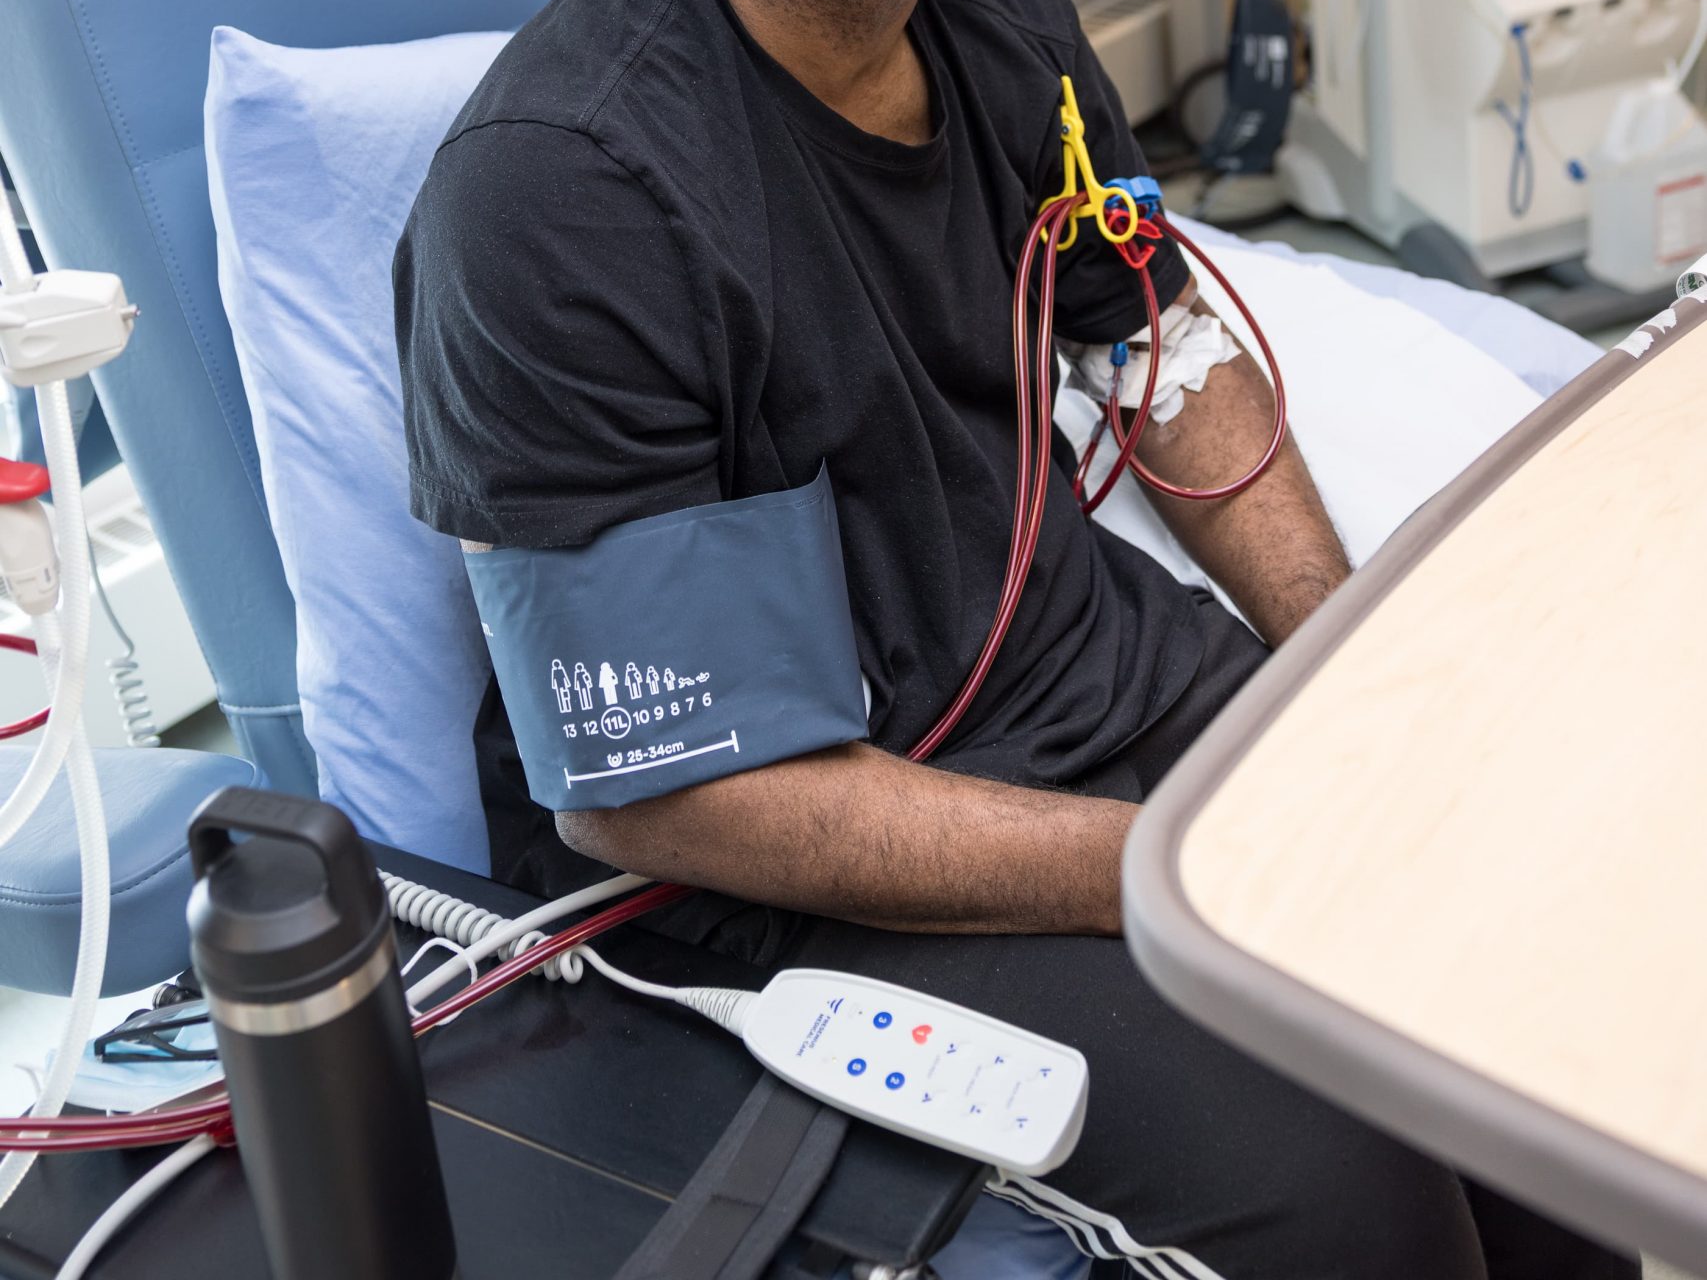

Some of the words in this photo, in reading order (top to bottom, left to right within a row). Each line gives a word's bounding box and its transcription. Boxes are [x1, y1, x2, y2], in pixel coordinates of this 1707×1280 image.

[563, 724, 578, 738] 13
[583, 721, 599, 736] 12
[604, 717, 628, 731] 11L
[633, 710, 650, 726] 10
[654, 706, 664, 720] 9
[670, 702, 680, 716] 8
[685, 697, 695, 712] 7
[702, 692, 712, 707] 6
[627, 741, 685, 763] 25-34cm
